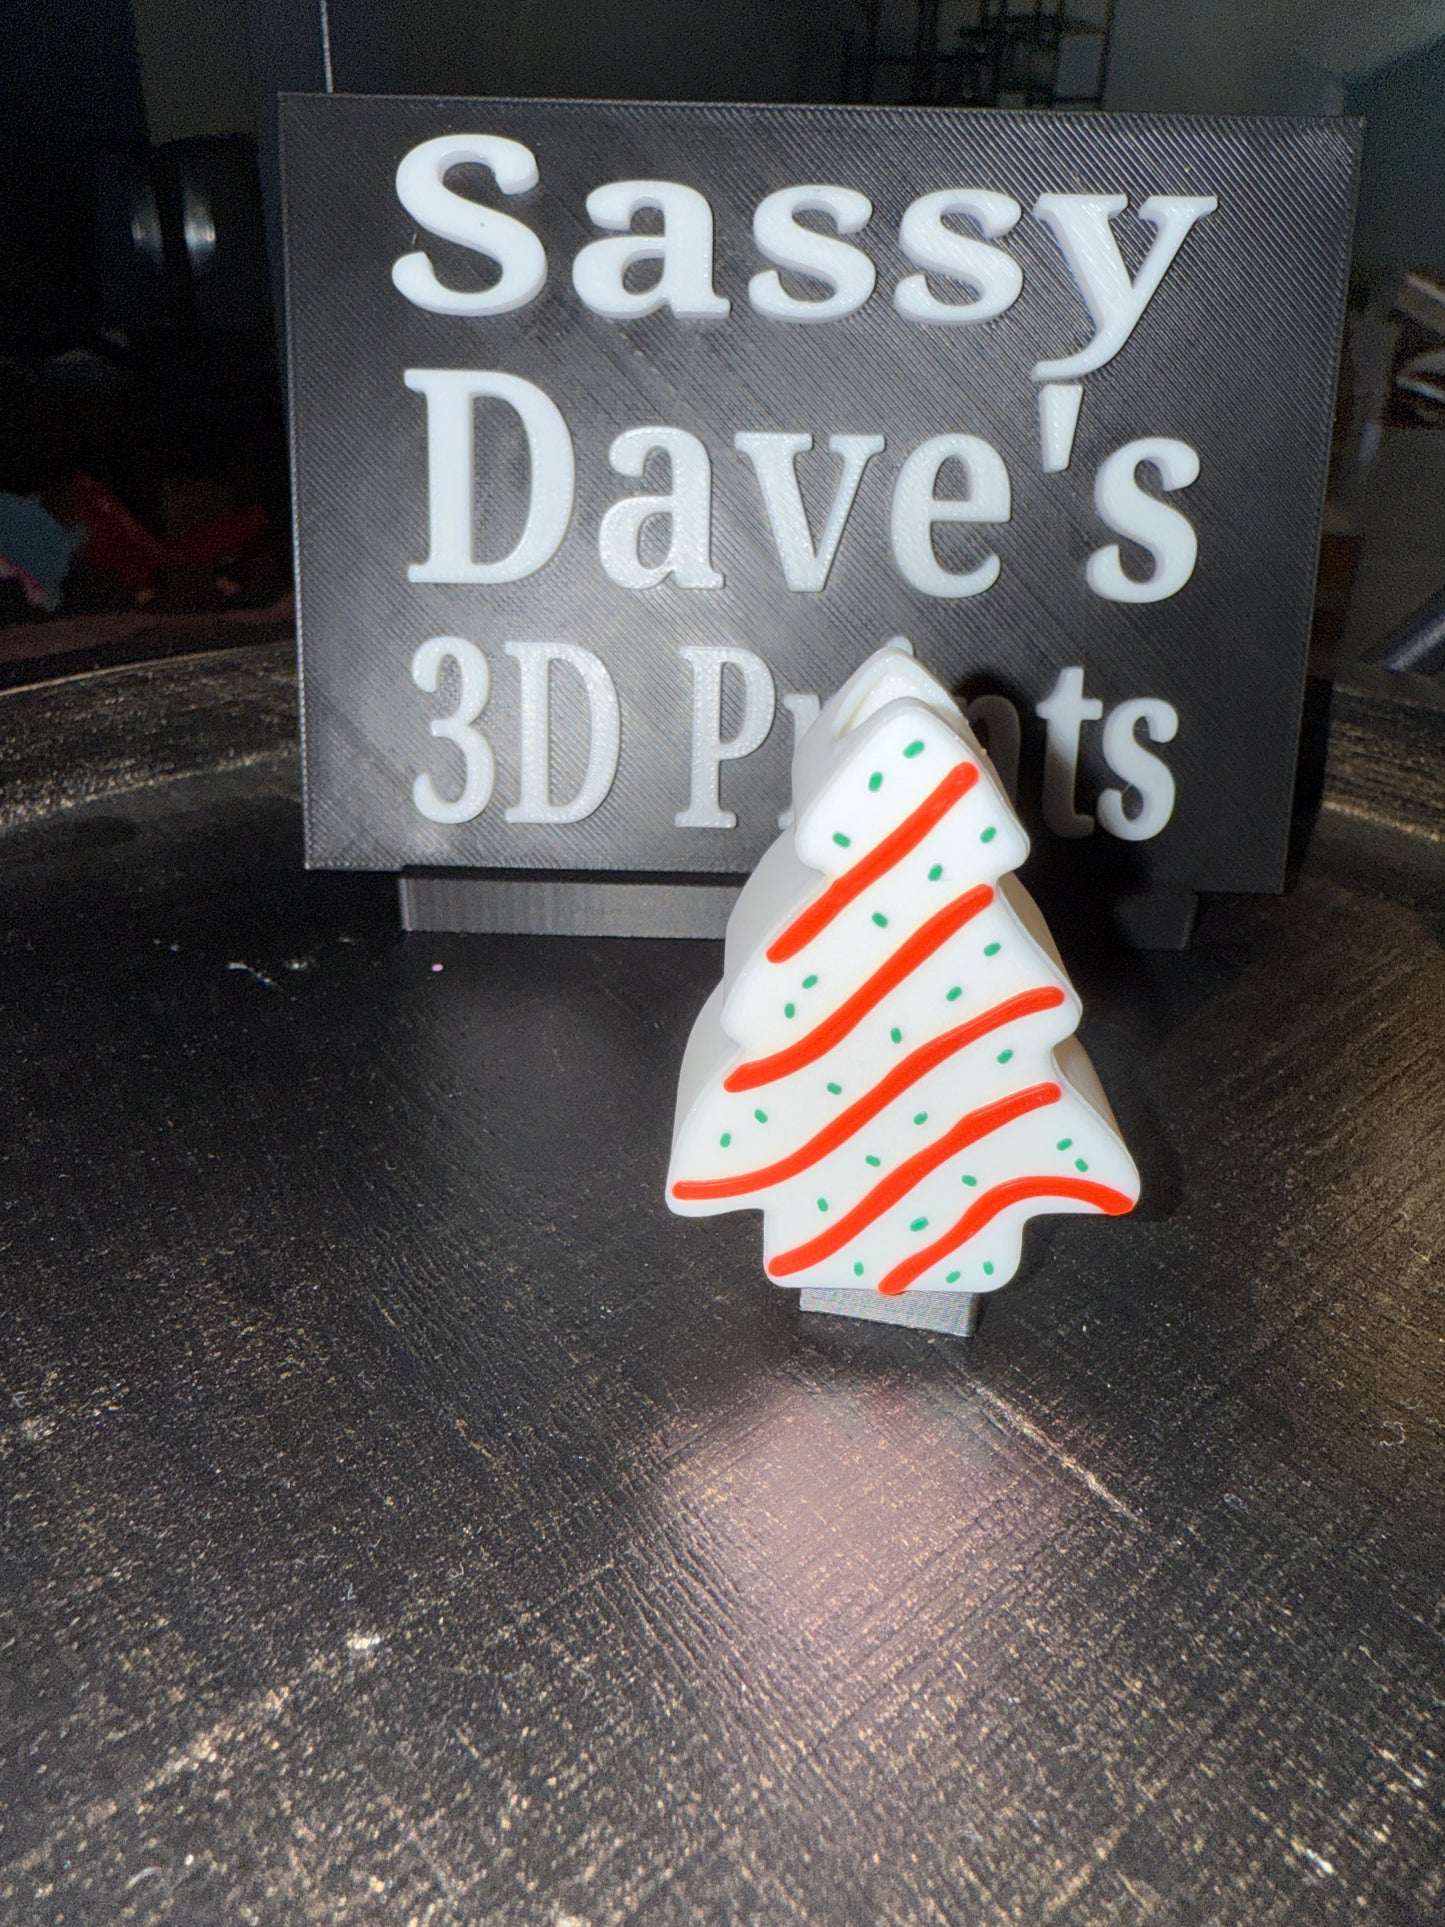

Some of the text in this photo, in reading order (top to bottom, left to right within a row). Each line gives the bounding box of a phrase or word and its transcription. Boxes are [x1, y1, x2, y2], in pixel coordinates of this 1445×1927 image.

[391, 133, 1219, 382] Sassy
[403, 367, 1202, 603] Dave's
[411, 636, 1179, 842] 3D Pts
